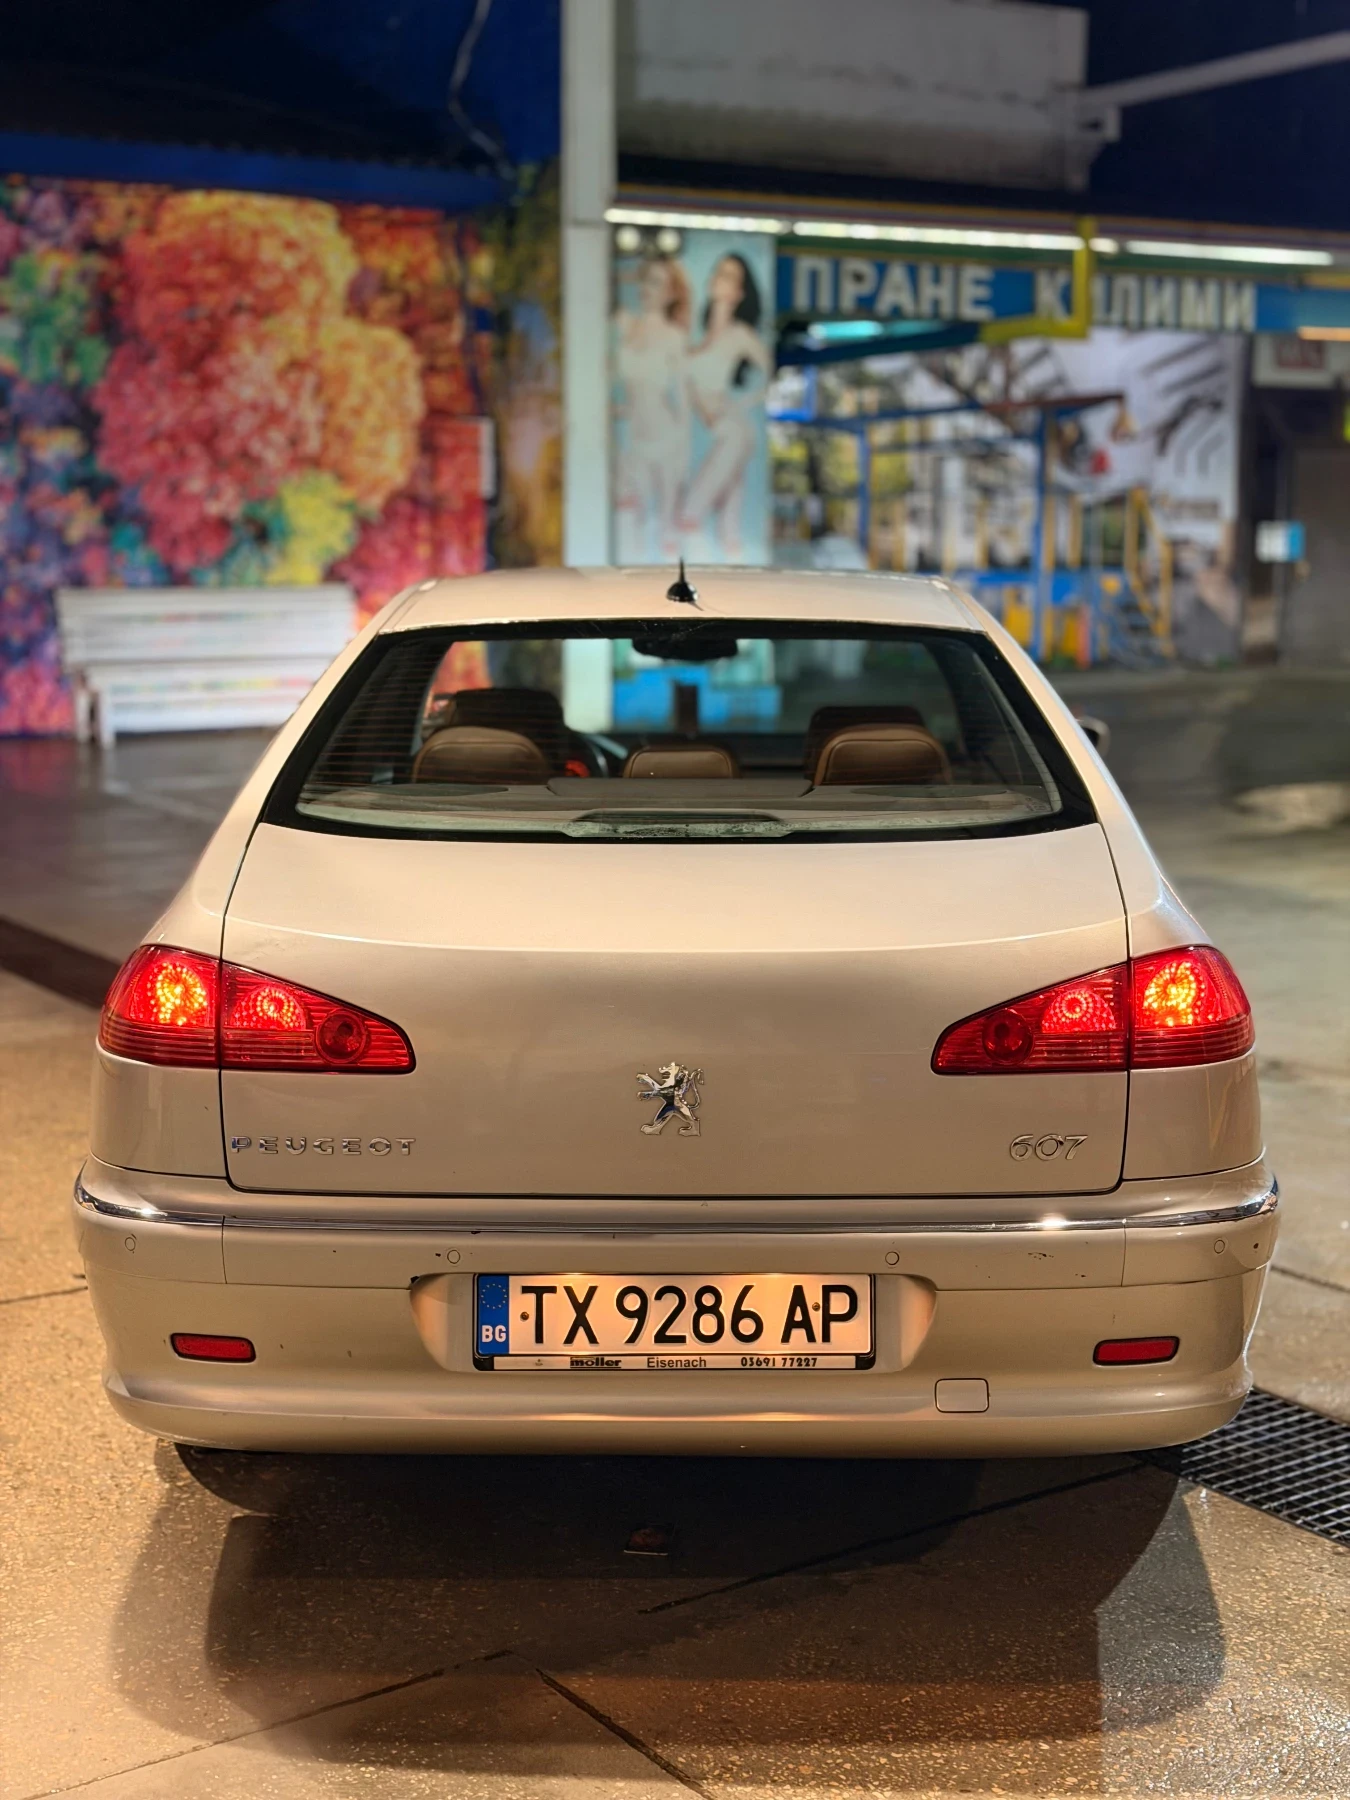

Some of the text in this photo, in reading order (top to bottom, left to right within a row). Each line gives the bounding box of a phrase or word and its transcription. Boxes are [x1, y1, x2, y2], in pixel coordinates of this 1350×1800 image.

[793, 255, 996, 321] ПРАНЕ
[231, 1136, 416, 1156] PEUGEOT
[1010, 1134, 1088, 1161] 607
[521, 1284, 858, 1345] TX 9286 AP
[481, 1324, 507, 1343] BG
[647, 1356, 707, 1368] Eisenach
[741, 1356, 776, 1367] 03691
[781, 1357, 818, 1367] 77227
